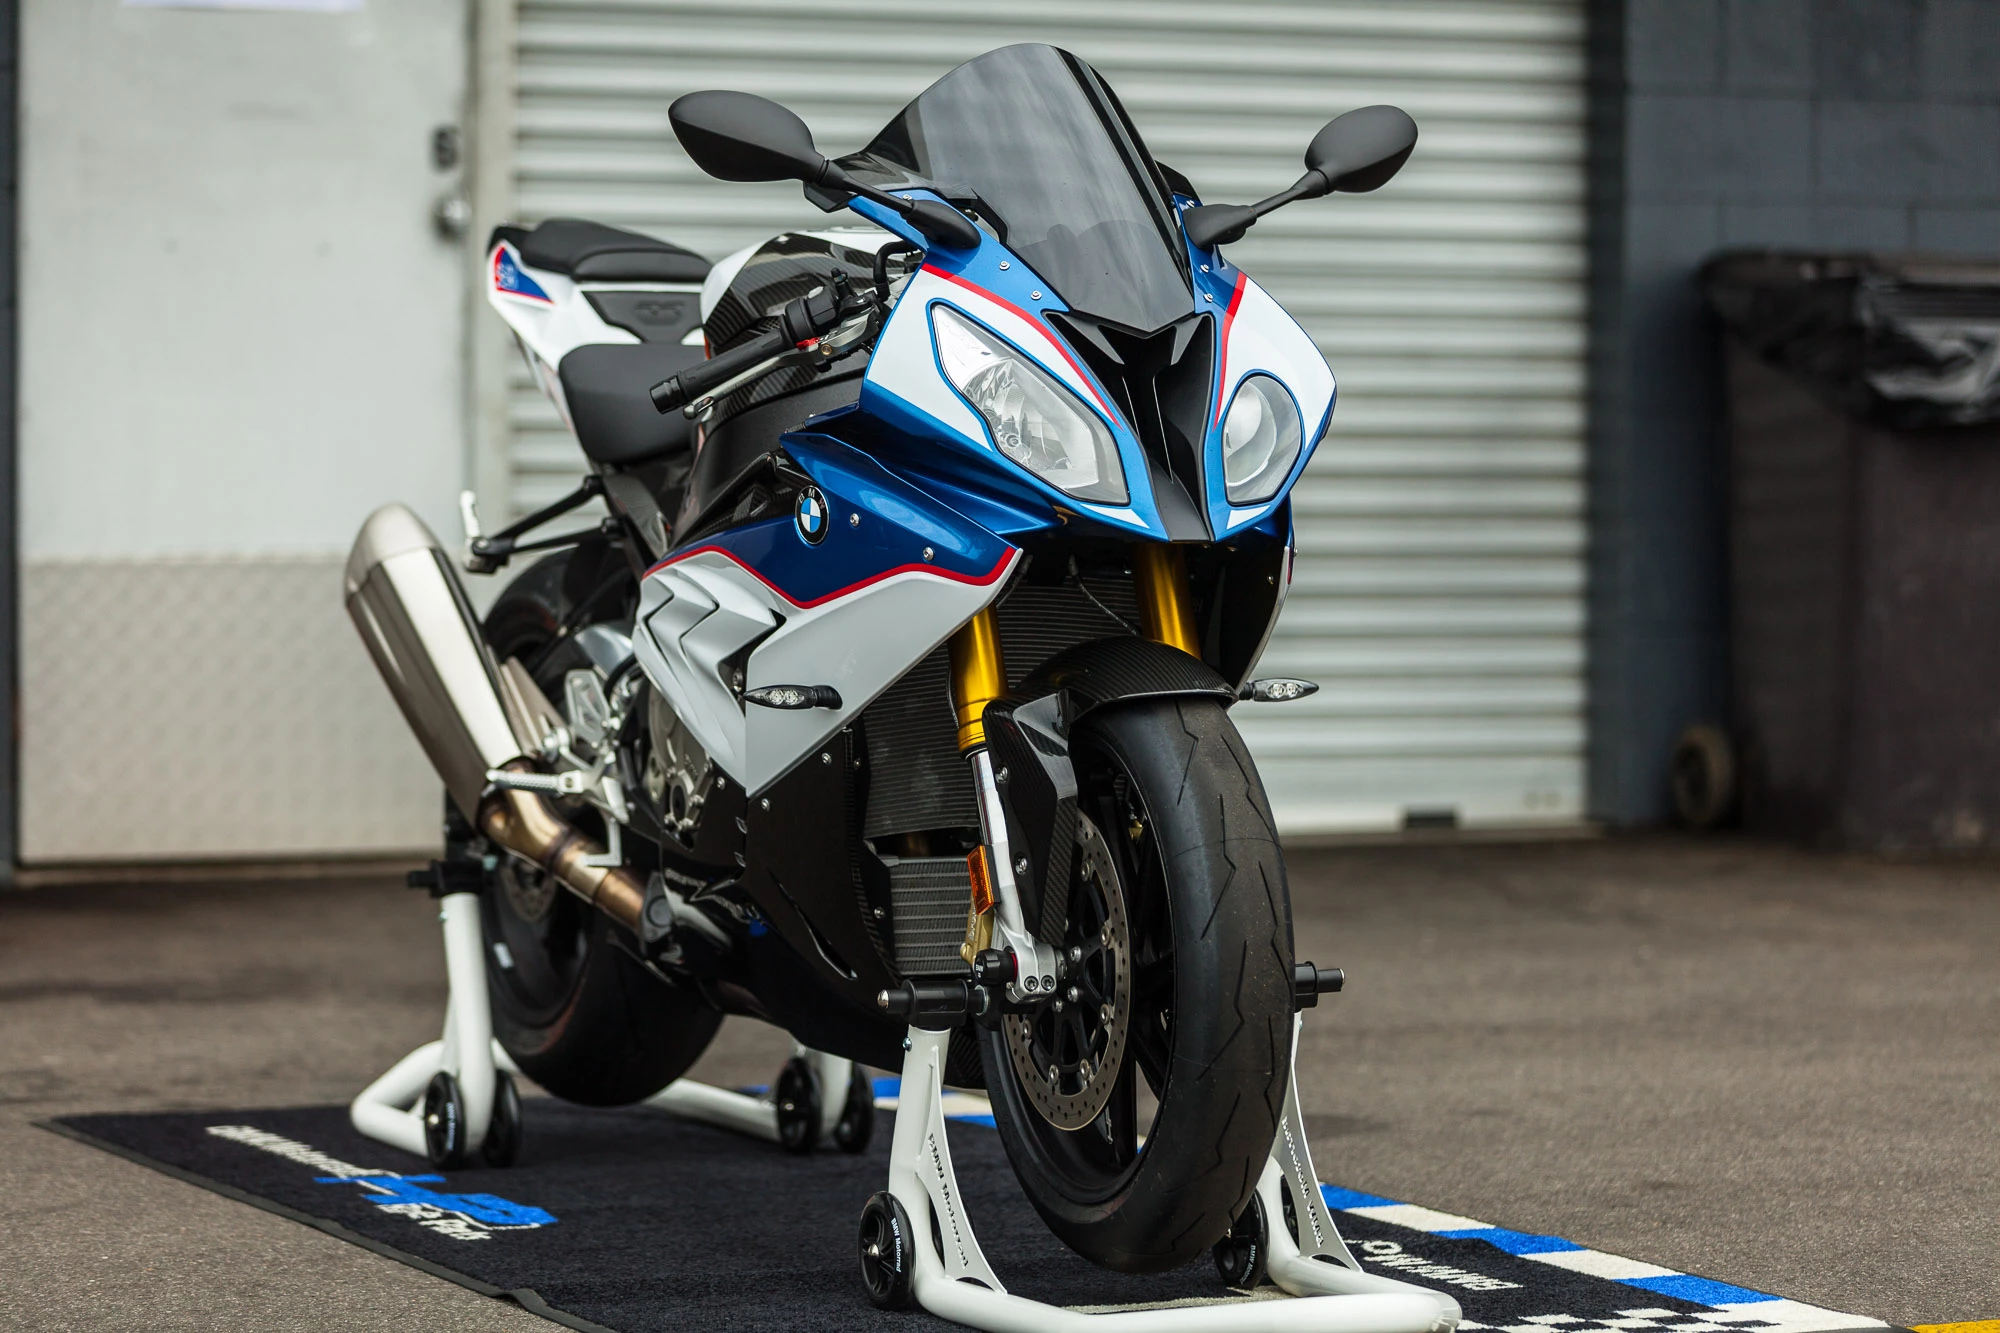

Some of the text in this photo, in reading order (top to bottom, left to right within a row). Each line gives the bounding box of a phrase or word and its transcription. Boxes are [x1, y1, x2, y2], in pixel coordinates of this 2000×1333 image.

[799, 488, 825, 509] BMW
[928, 1133, 969, 1269] BMW Motorrad
[890, 1217, 902, 1273] BMW Motorrad
